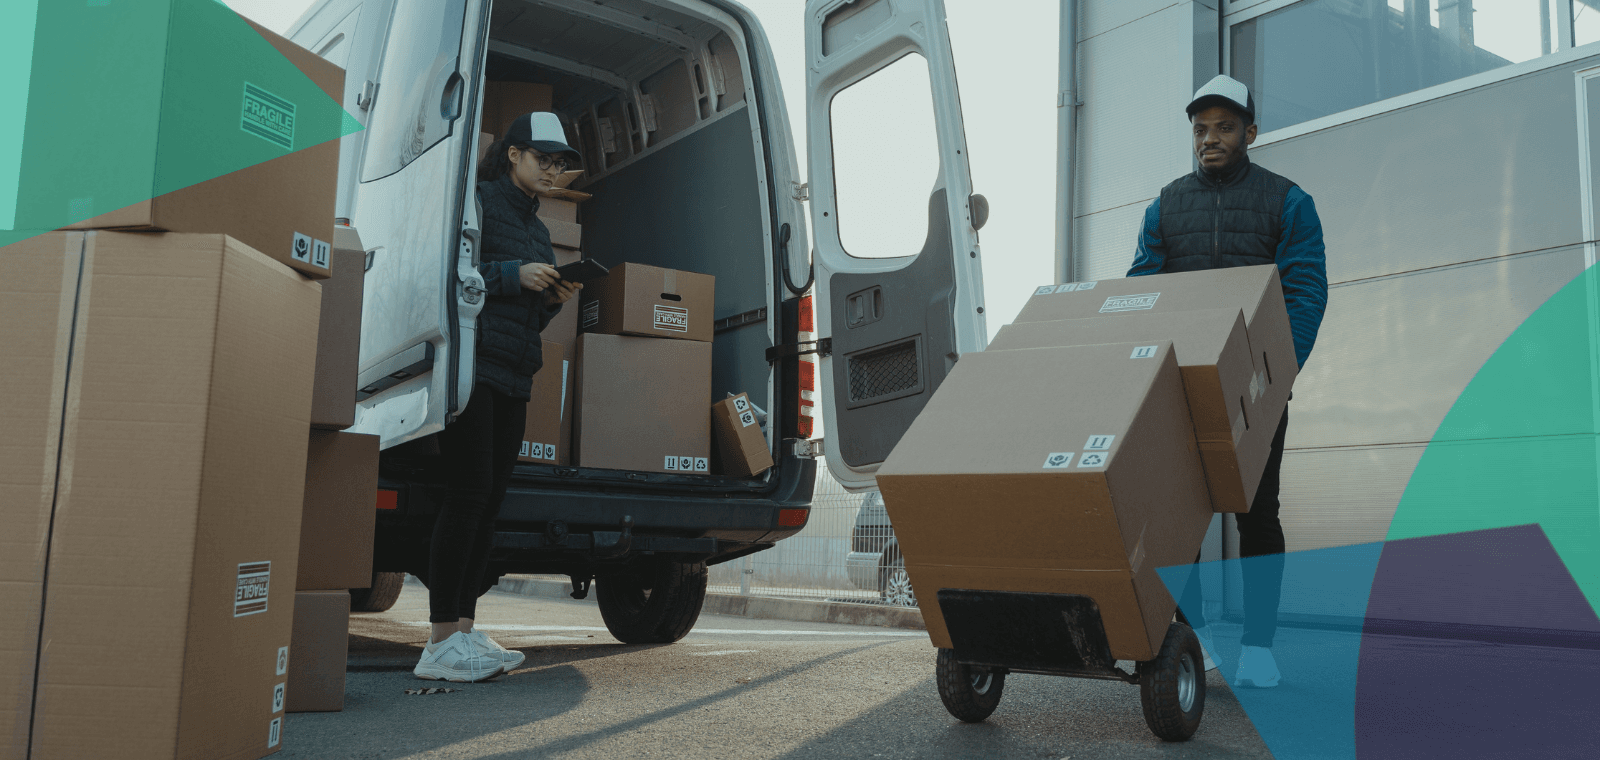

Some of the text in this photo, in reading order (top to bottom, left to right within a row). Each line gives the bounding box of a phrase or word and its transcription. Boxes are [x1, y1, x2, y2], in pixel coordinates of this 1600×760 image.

[244, 98, 293, 130] FRAGILE
[655, 315, 686, 325] FRAGILE
[237, 583, 269, 600] FRAGILE
